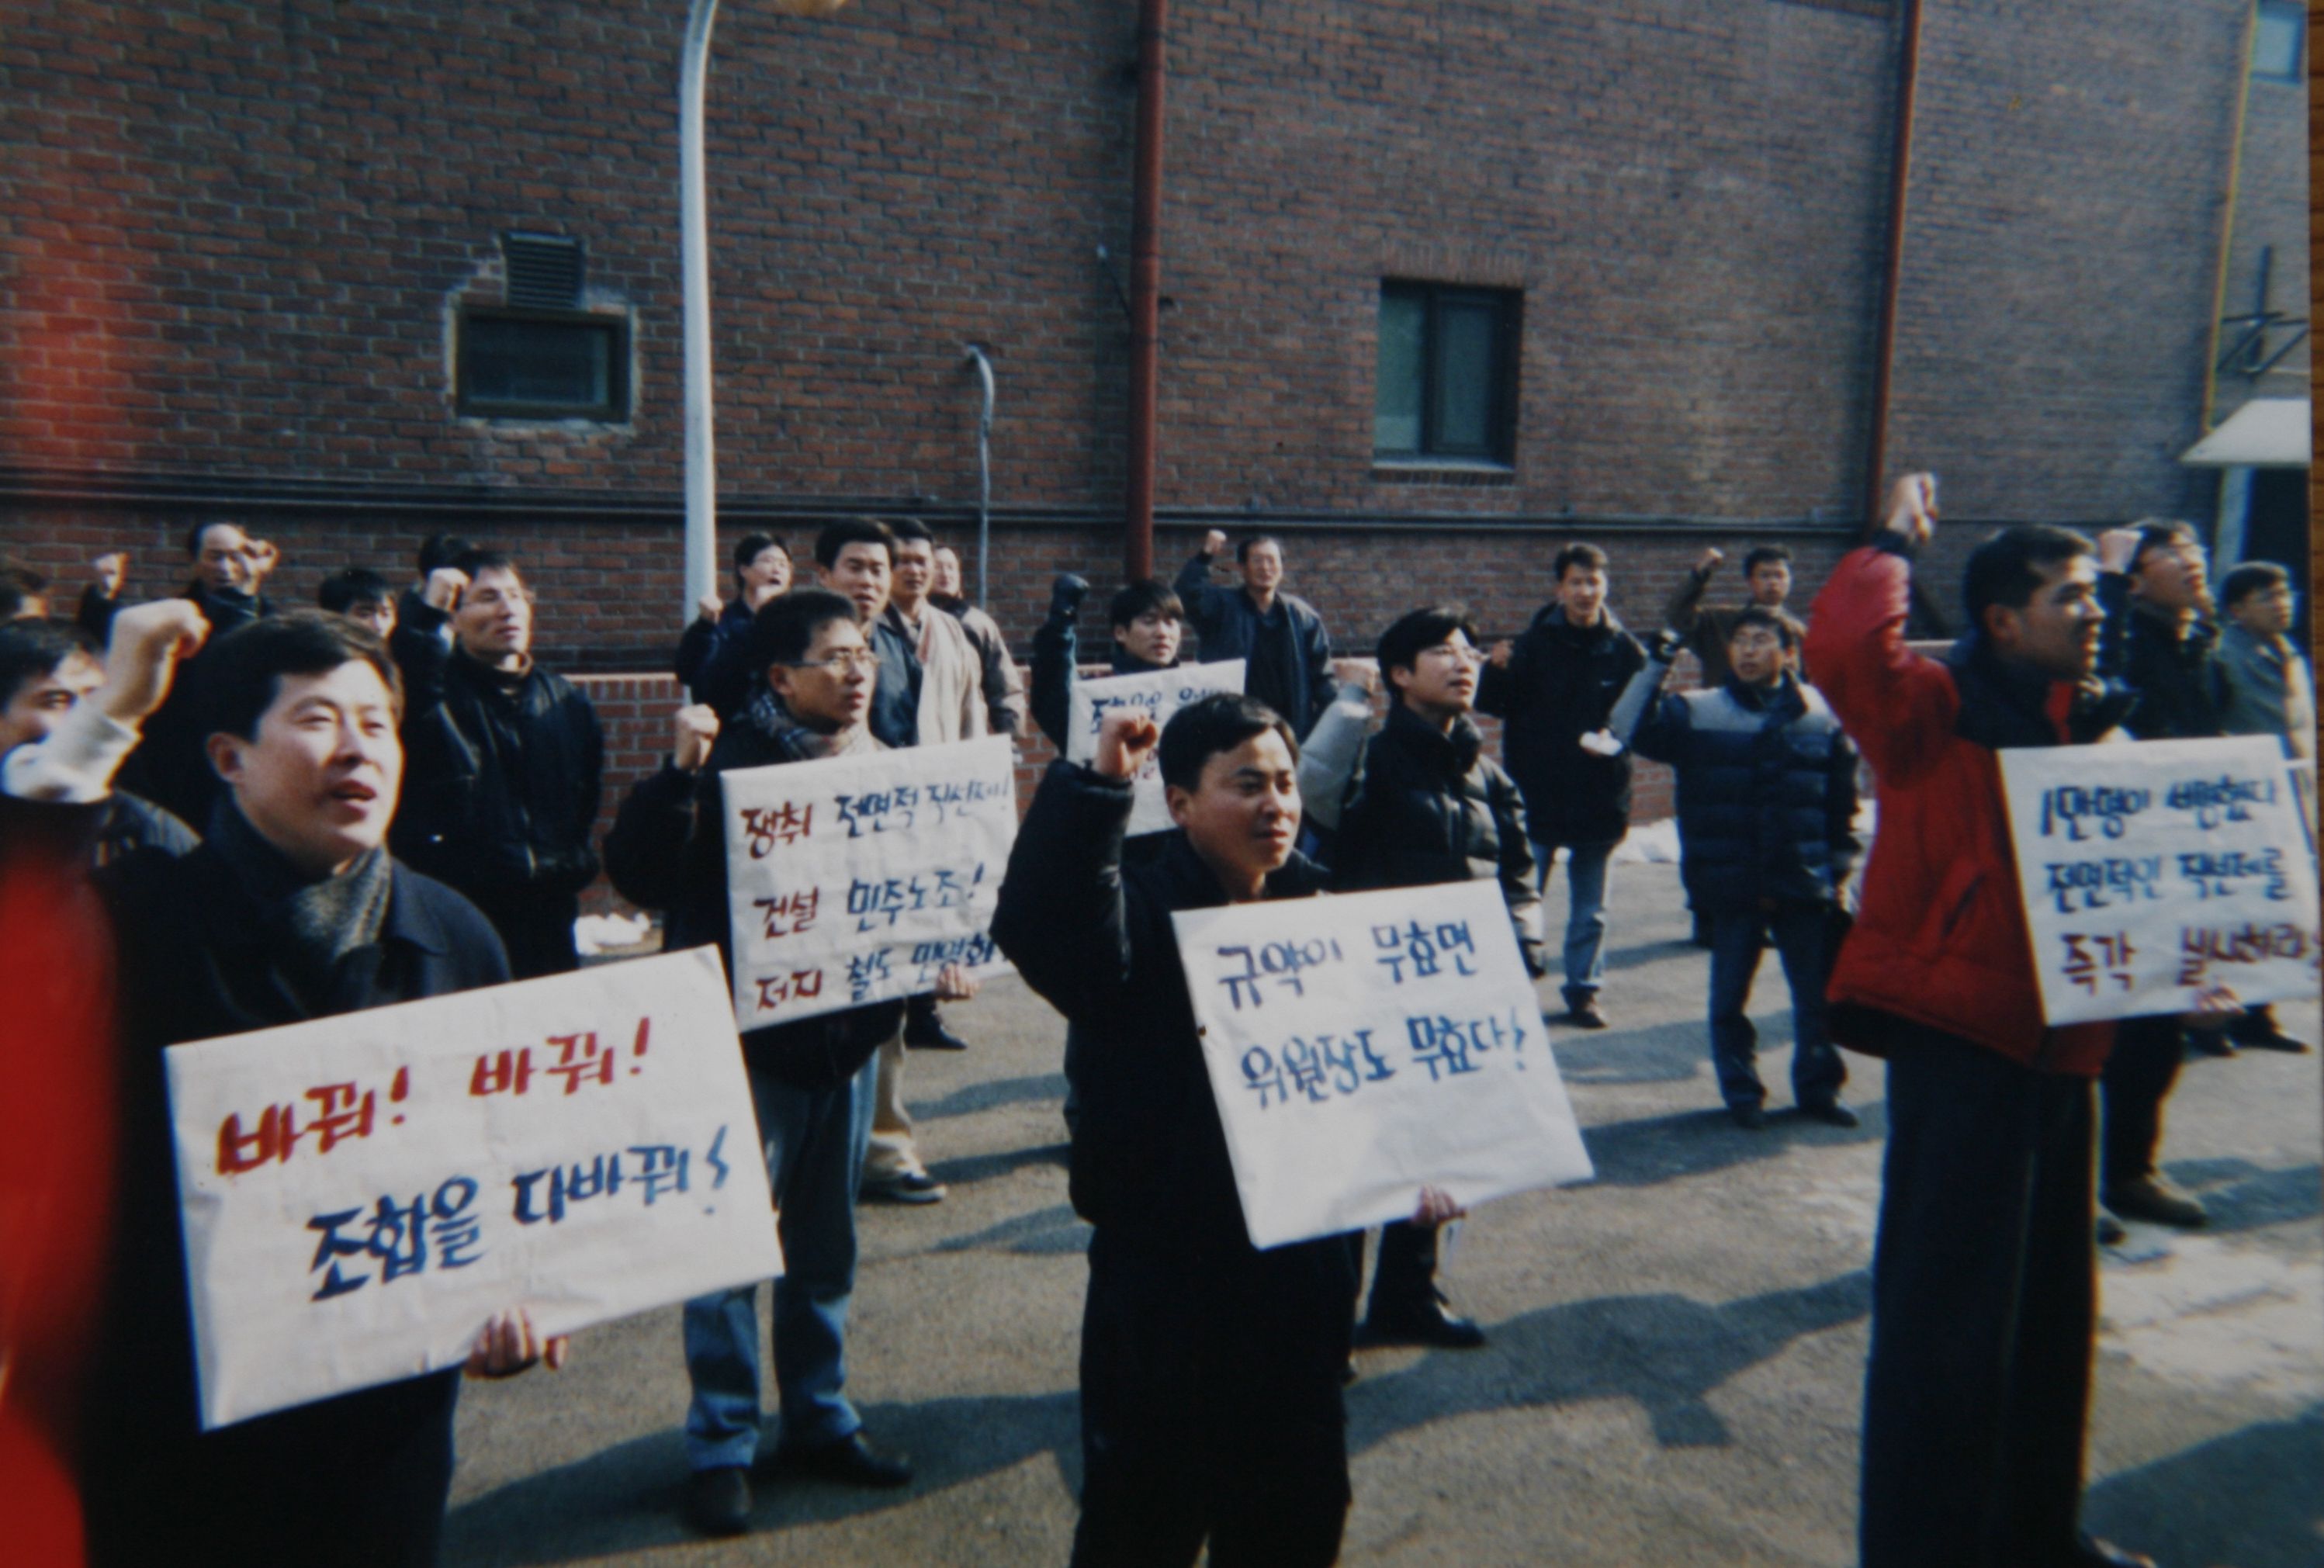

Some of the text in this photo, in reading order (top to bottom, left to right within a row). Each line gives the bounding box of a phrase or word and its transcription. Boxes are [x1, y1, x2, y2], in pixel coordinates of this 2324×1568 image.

[740, 801, 813, 860] 쟁취
[834, 785, 920, 839] 전면적
[752, 862, 985, 940] 건설 민주노조!
[755, 968, 823, 1012] 저지
[845, 947, 894, 1004] 철도
[1216, 920, 1480, 1011] 규약이 무효면
[2060, 931, 2138, 996] 즉각
[216, 1016, 651, 1176] 바꿔! 바꿔!
[1240, 1006, 1526, 1111] 위원장도 무효다!
[306, 1174, 486, 1303] 조합을
